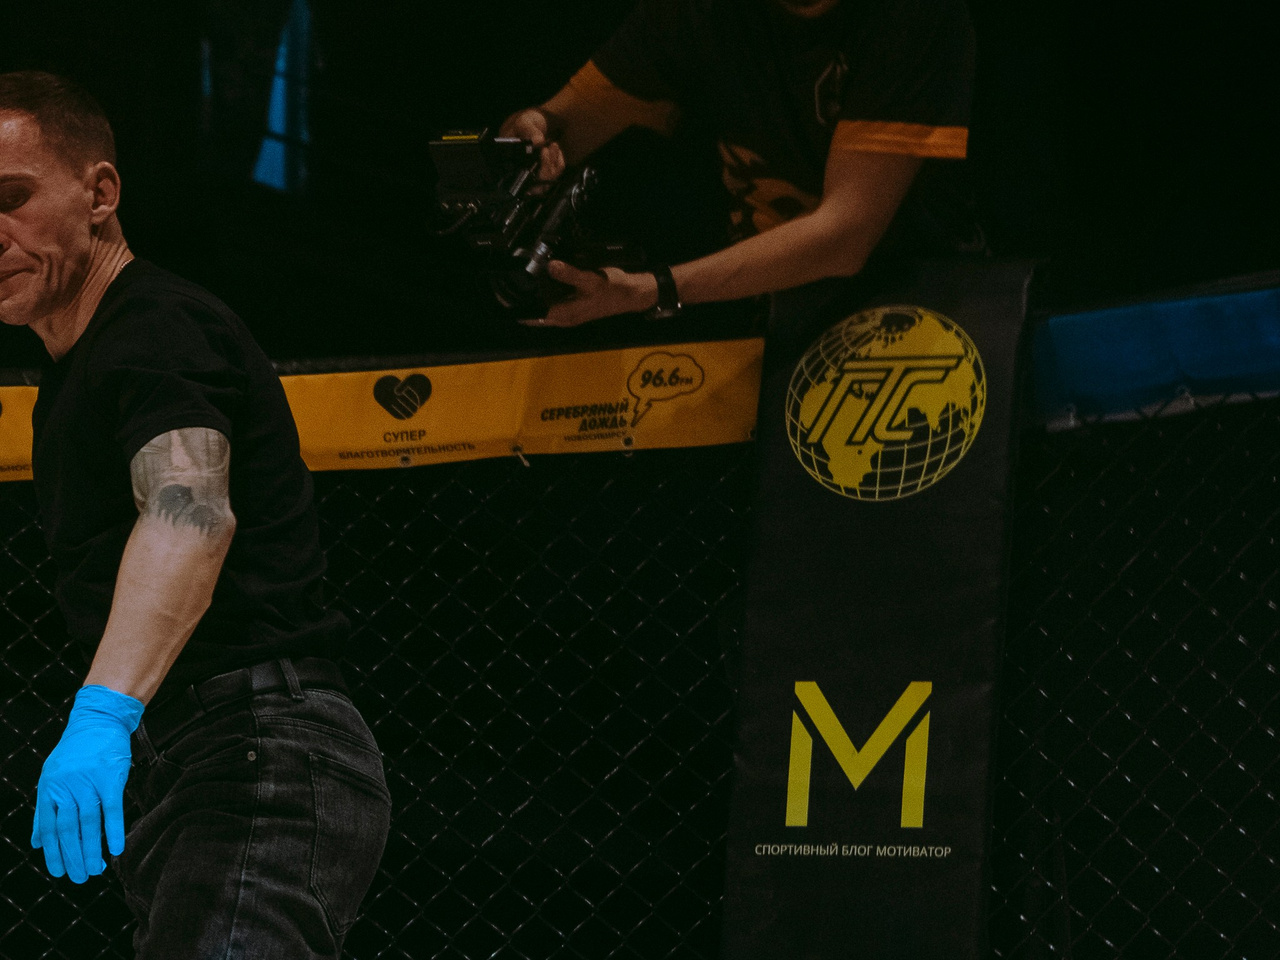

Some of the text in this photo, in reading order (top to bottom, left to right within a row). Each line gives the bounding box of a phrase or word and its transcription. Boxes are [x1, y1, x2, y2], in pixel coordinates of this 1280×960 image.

[541, 399, 629, 421] СЕРЕБРЯНЫЙ
[578, 415, 628, 432] ДОЖДЬ
[383, 429, 427, 443] СУПЕР
[338, 442, 476, 460] БЛАГОТВОРИТЕЛЬНОСТЬ
[754, 842, 952, 858] СПОРТИВНЫЙ БЛОГ МОТИВАТОР
